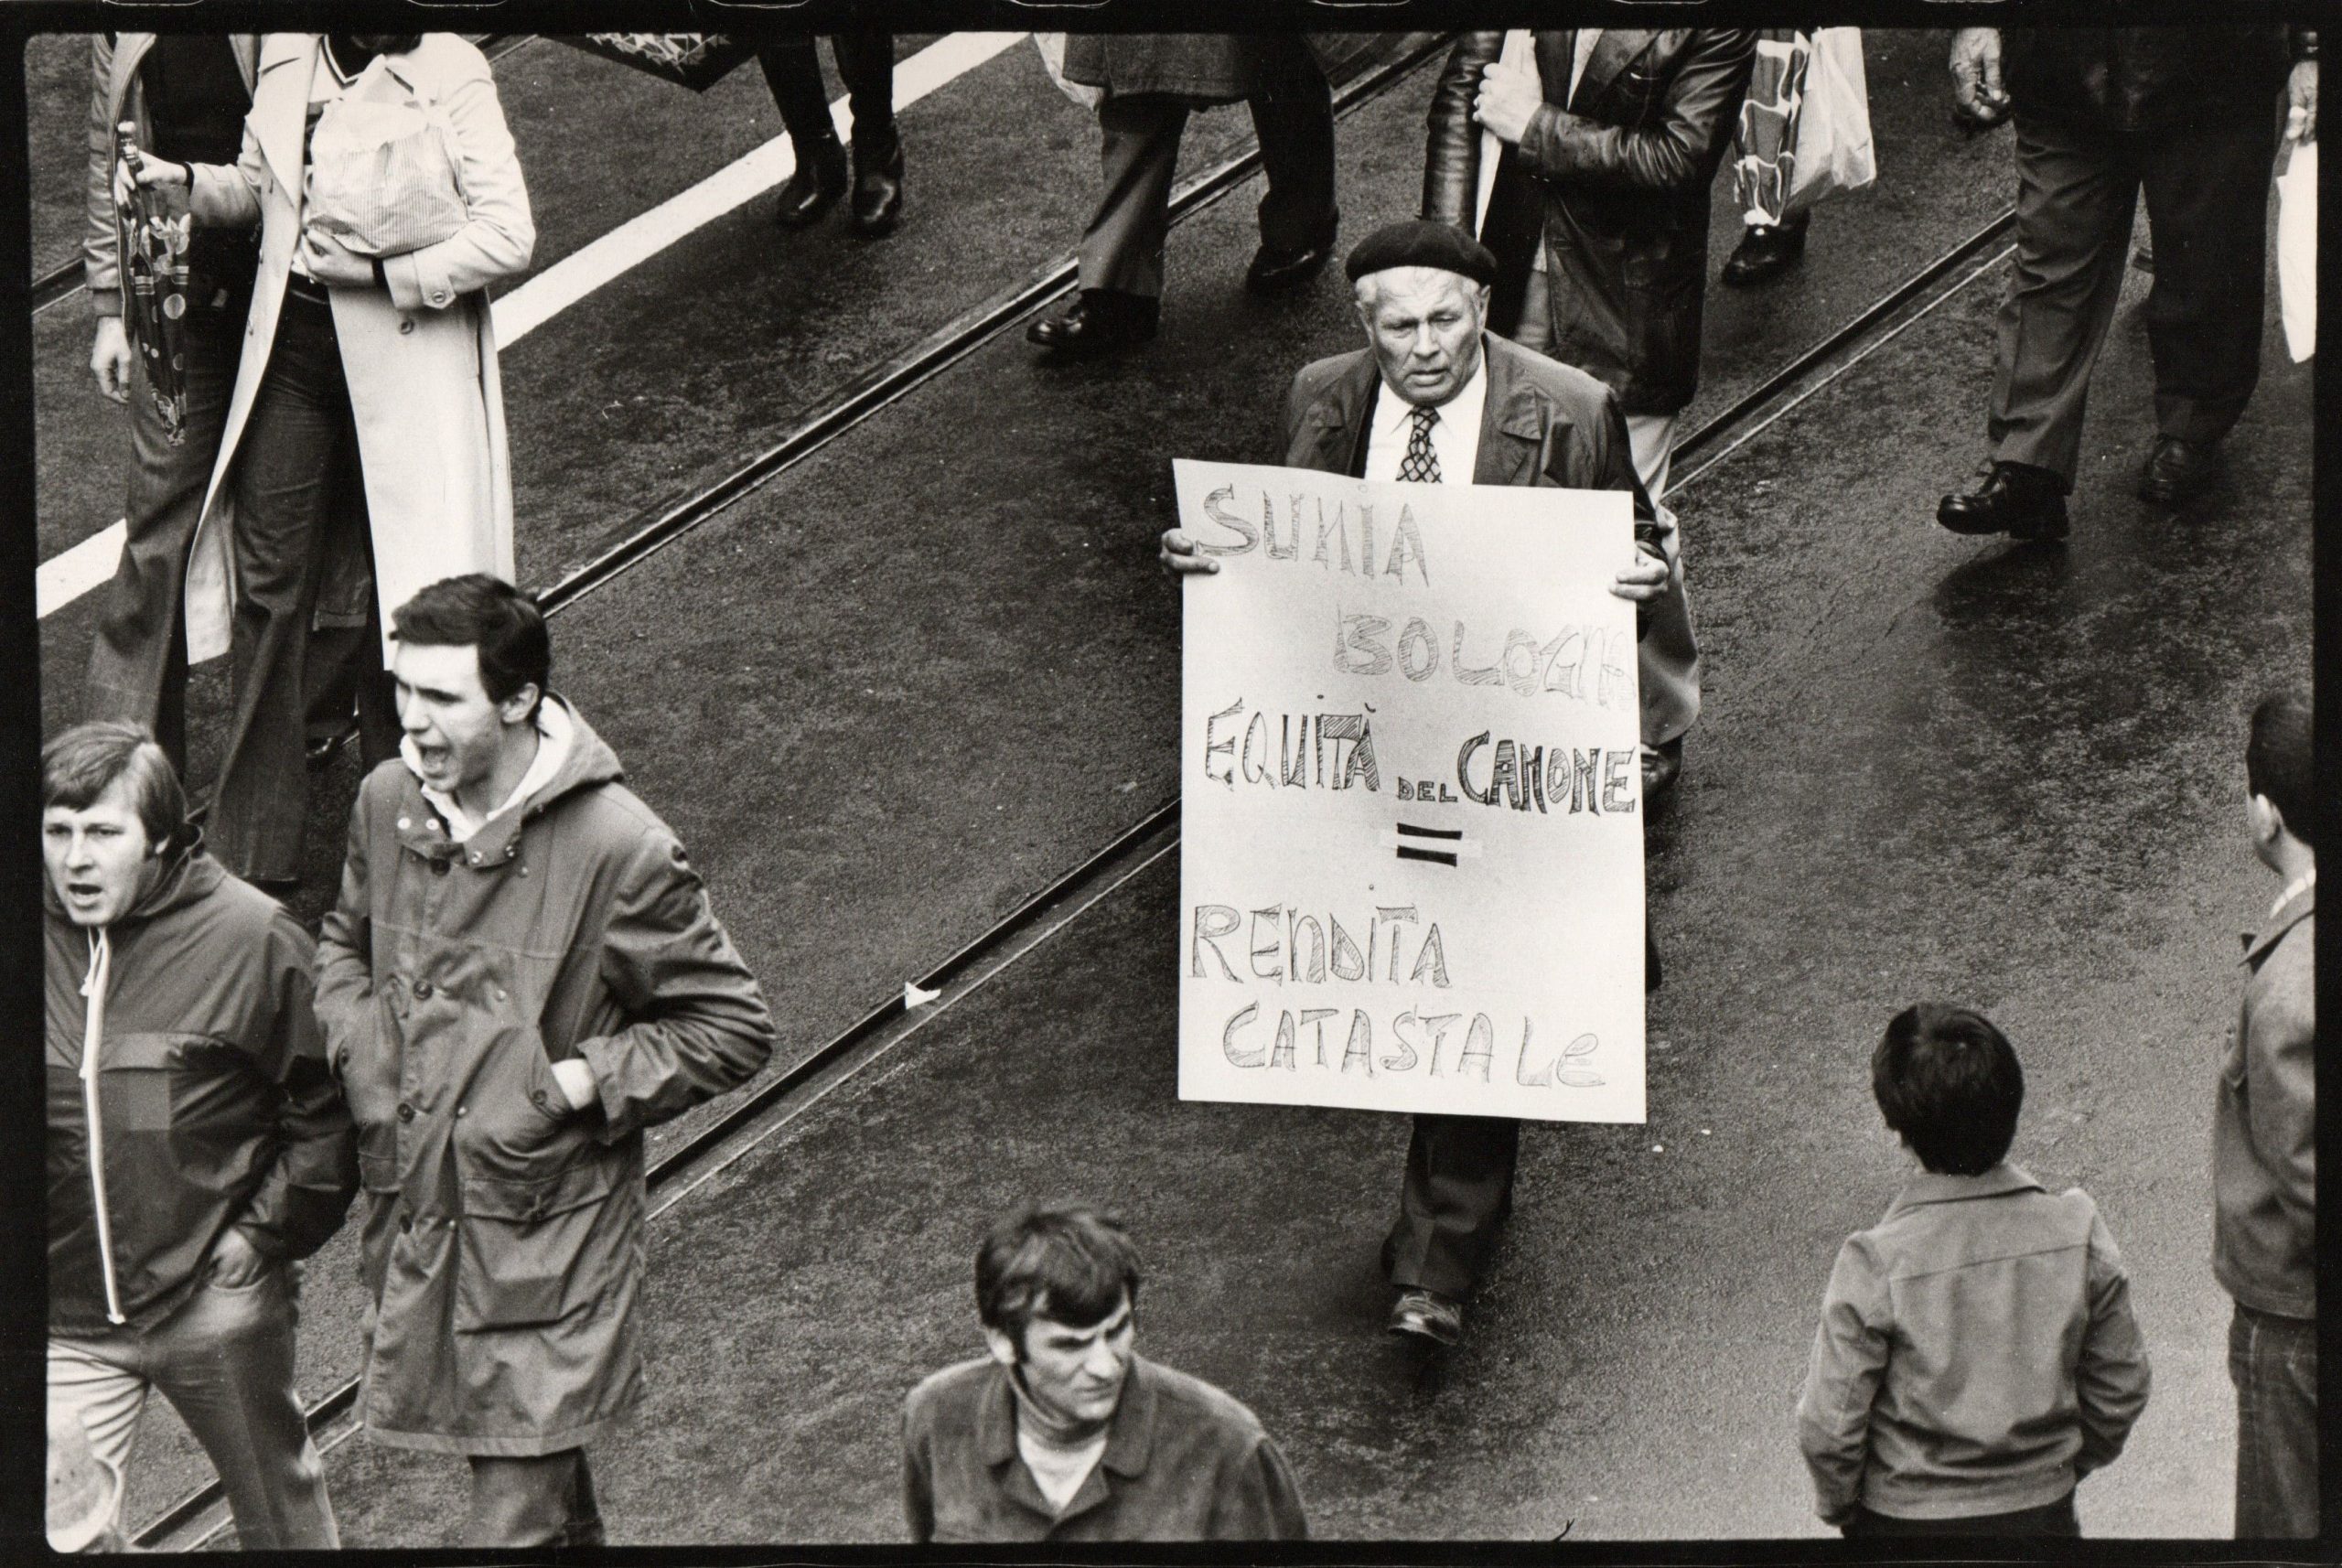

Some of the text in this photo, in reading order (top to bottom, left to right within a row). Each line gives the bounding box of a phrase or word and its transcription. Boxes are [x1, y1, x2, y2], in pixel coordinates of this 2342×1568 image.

[1196, 484, 1429, 587] SUNIA
[1397, 776, 1458, 802] DEL
[1456, 730, 1636, 817] CANONE
